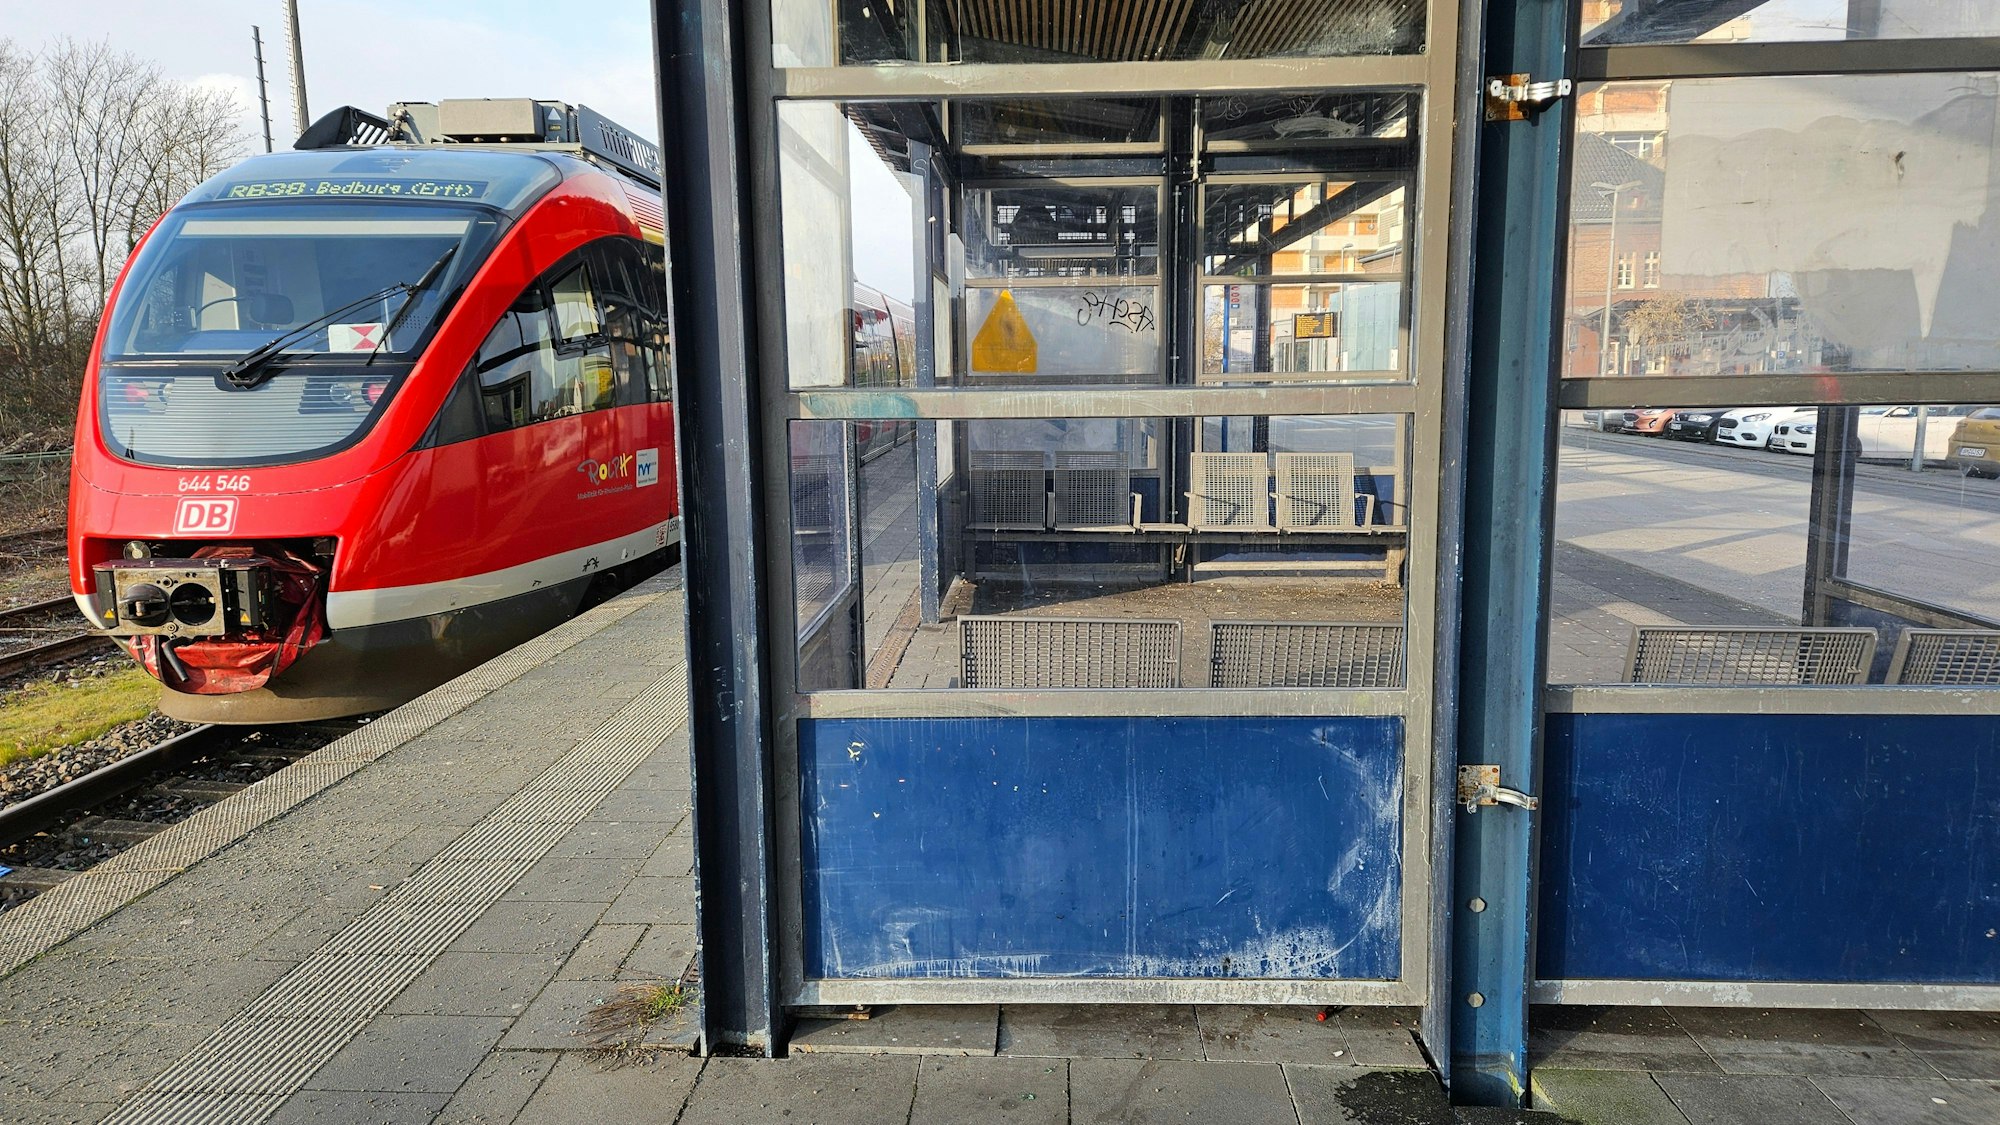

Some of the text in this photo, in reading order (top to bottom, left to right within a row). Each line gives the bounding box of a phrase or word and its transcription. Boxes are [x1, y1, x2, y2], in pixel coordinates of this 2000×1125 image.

[178, 475, 251, 492] 644 546
[181, 502, 230, 530] DB
